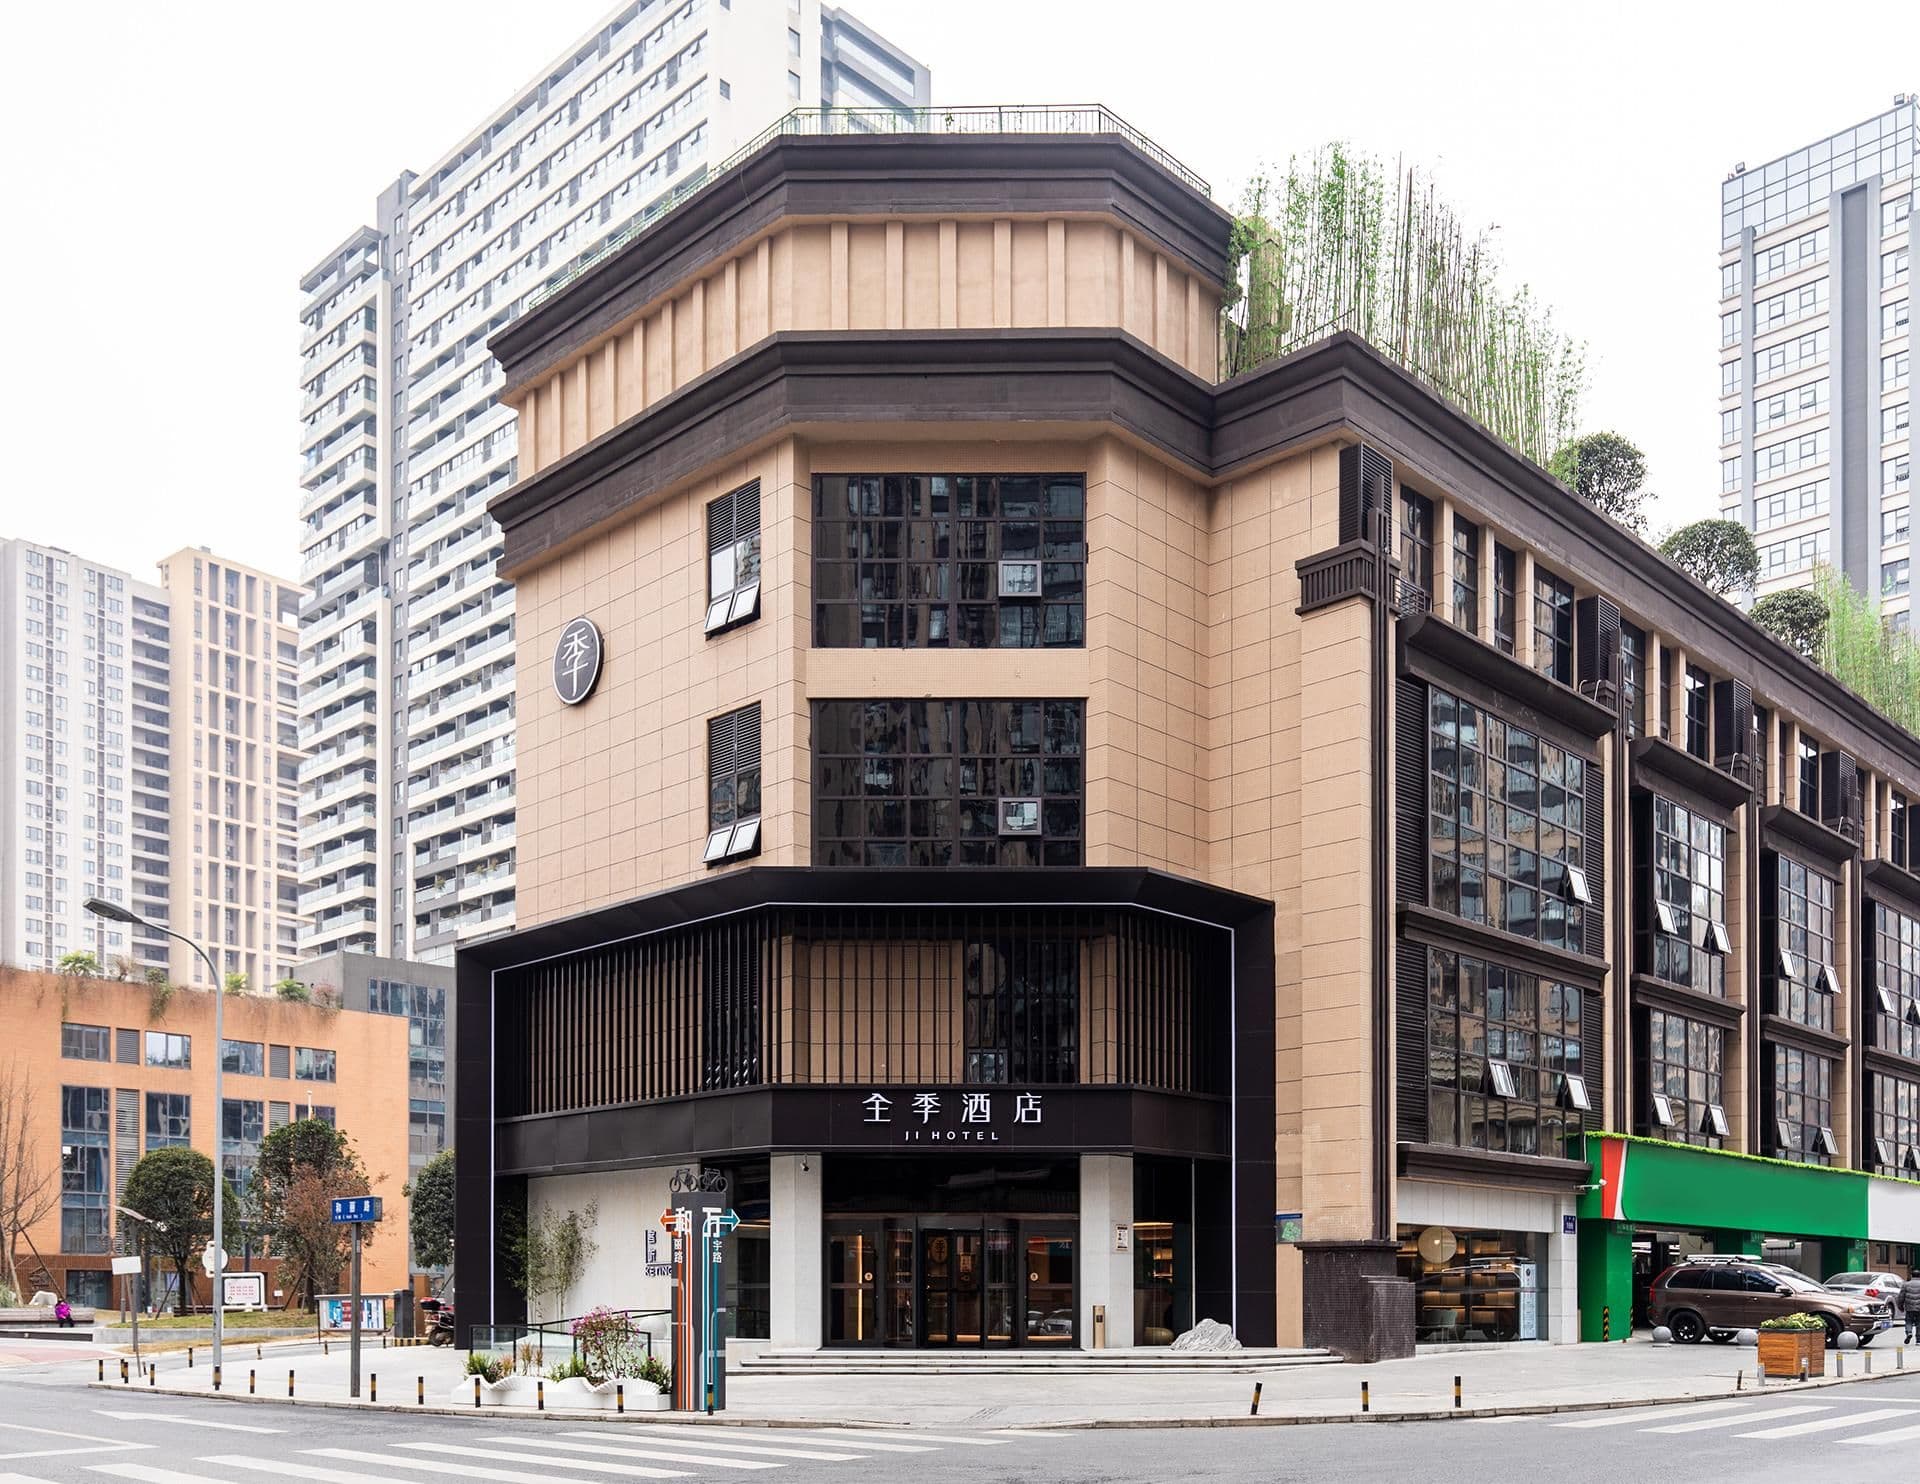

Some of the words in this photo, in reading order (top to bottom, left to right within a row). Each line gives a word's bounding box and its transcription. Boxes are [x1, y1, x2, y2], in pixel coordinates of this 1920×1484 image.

[561, 626, 590, 697] 季
[862, 1092, 1042, 1124] 全季酒店
[905, 1131, 919, 1141] JI
[931, 1131, 999, 1140] HOTEL
